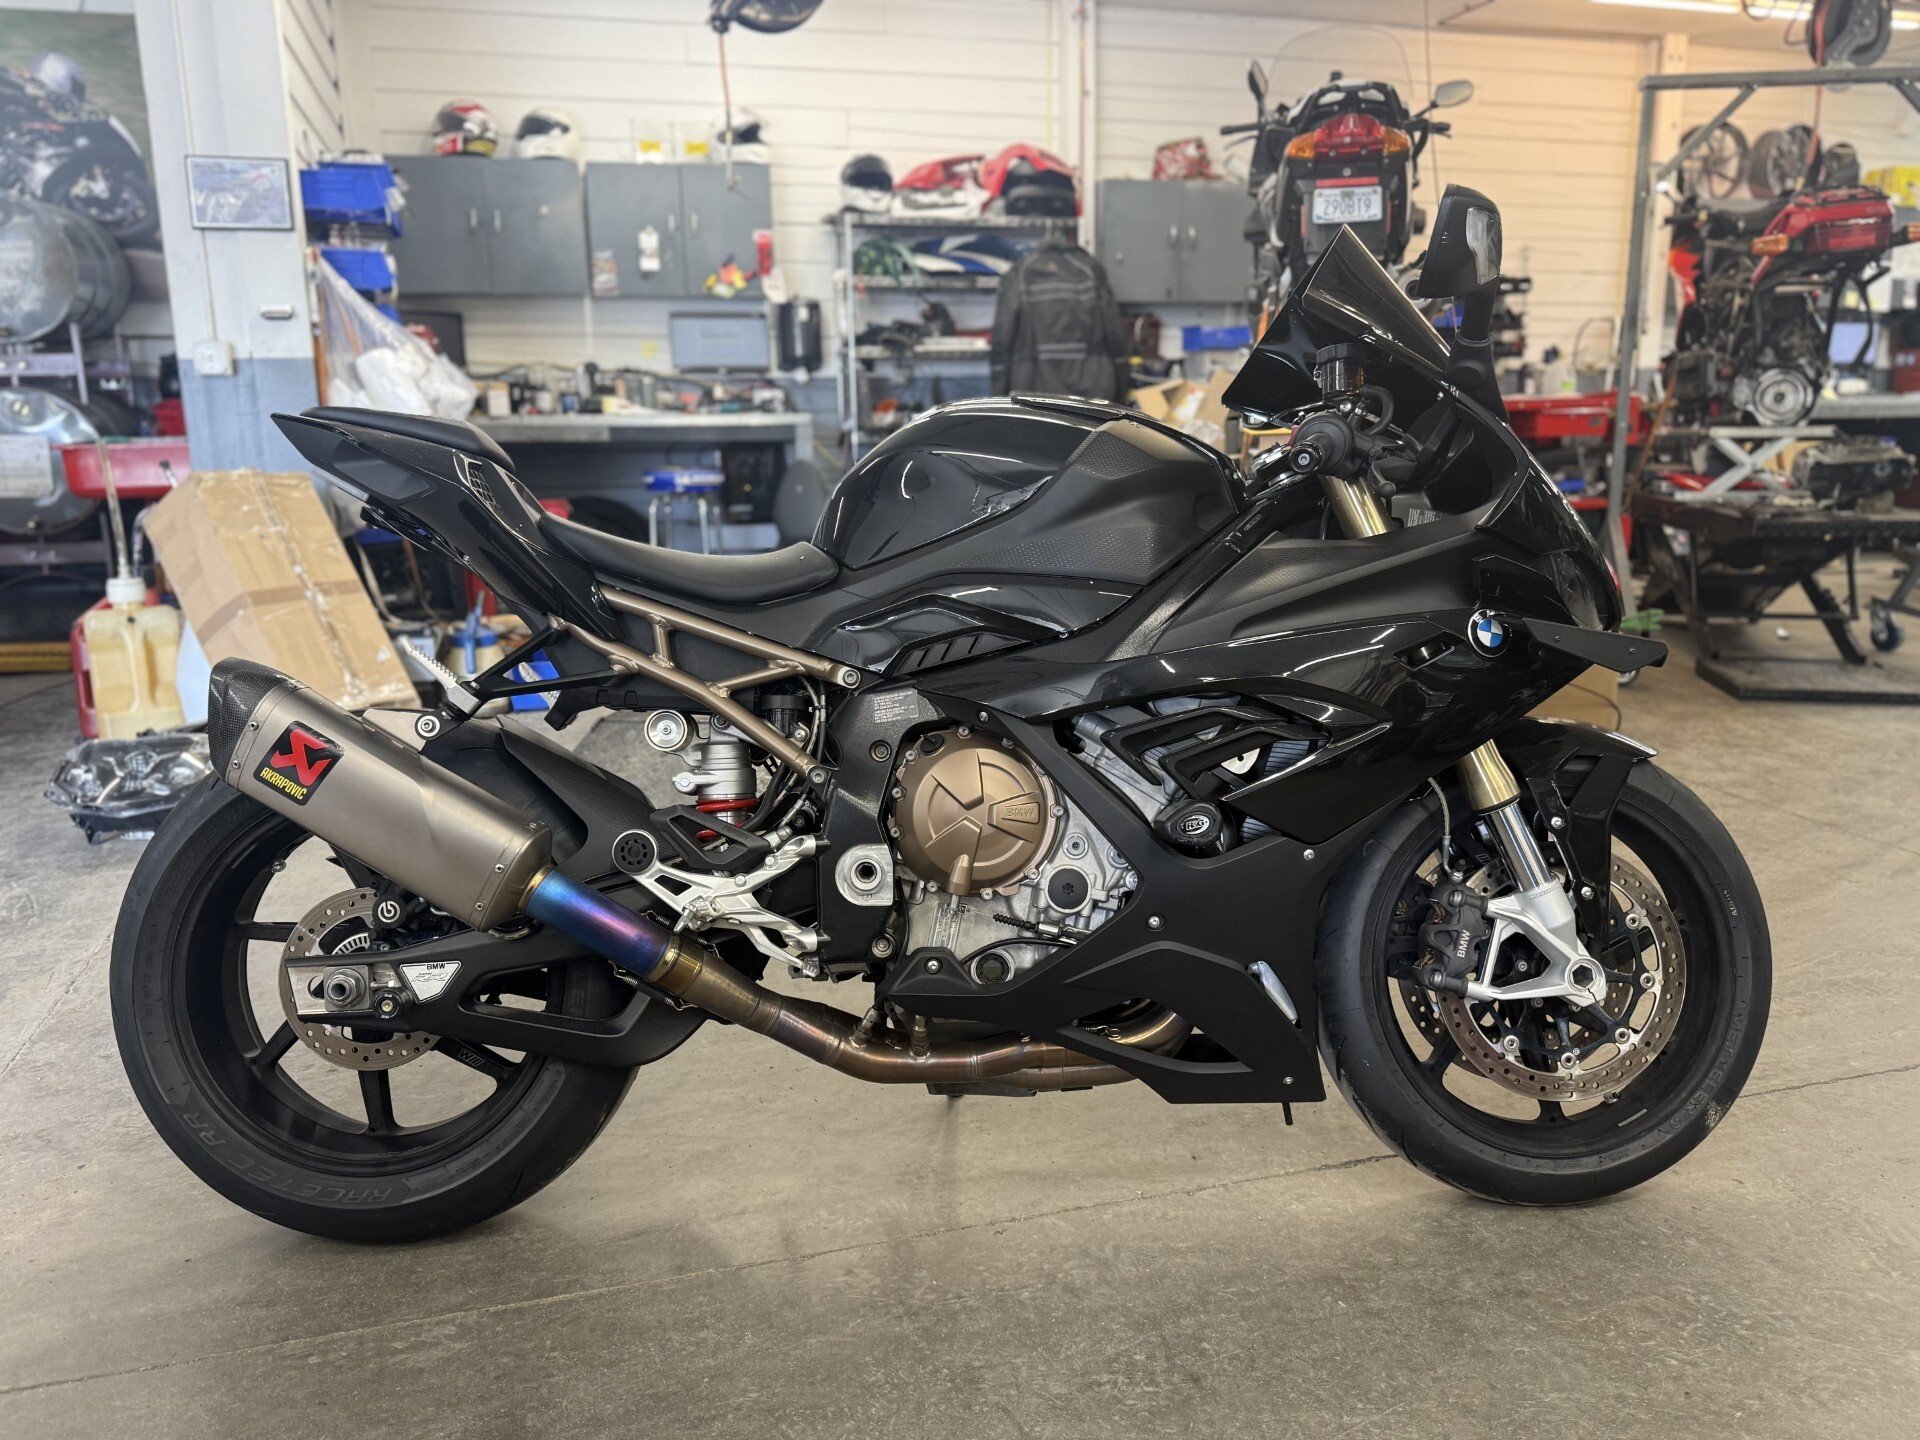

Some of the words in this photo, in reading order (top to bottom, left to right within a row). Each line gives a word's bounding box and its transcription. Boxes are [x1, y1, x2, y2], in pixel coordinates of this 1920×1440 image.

[1005, 807, 1036, 818] BMW
[1456, 929, 1472, 958] BMW
[426, 962, 446, 970] BMW
[183, 1112, 226, 1146] RR
[226, 1153, 393, 1203] RACETEC
